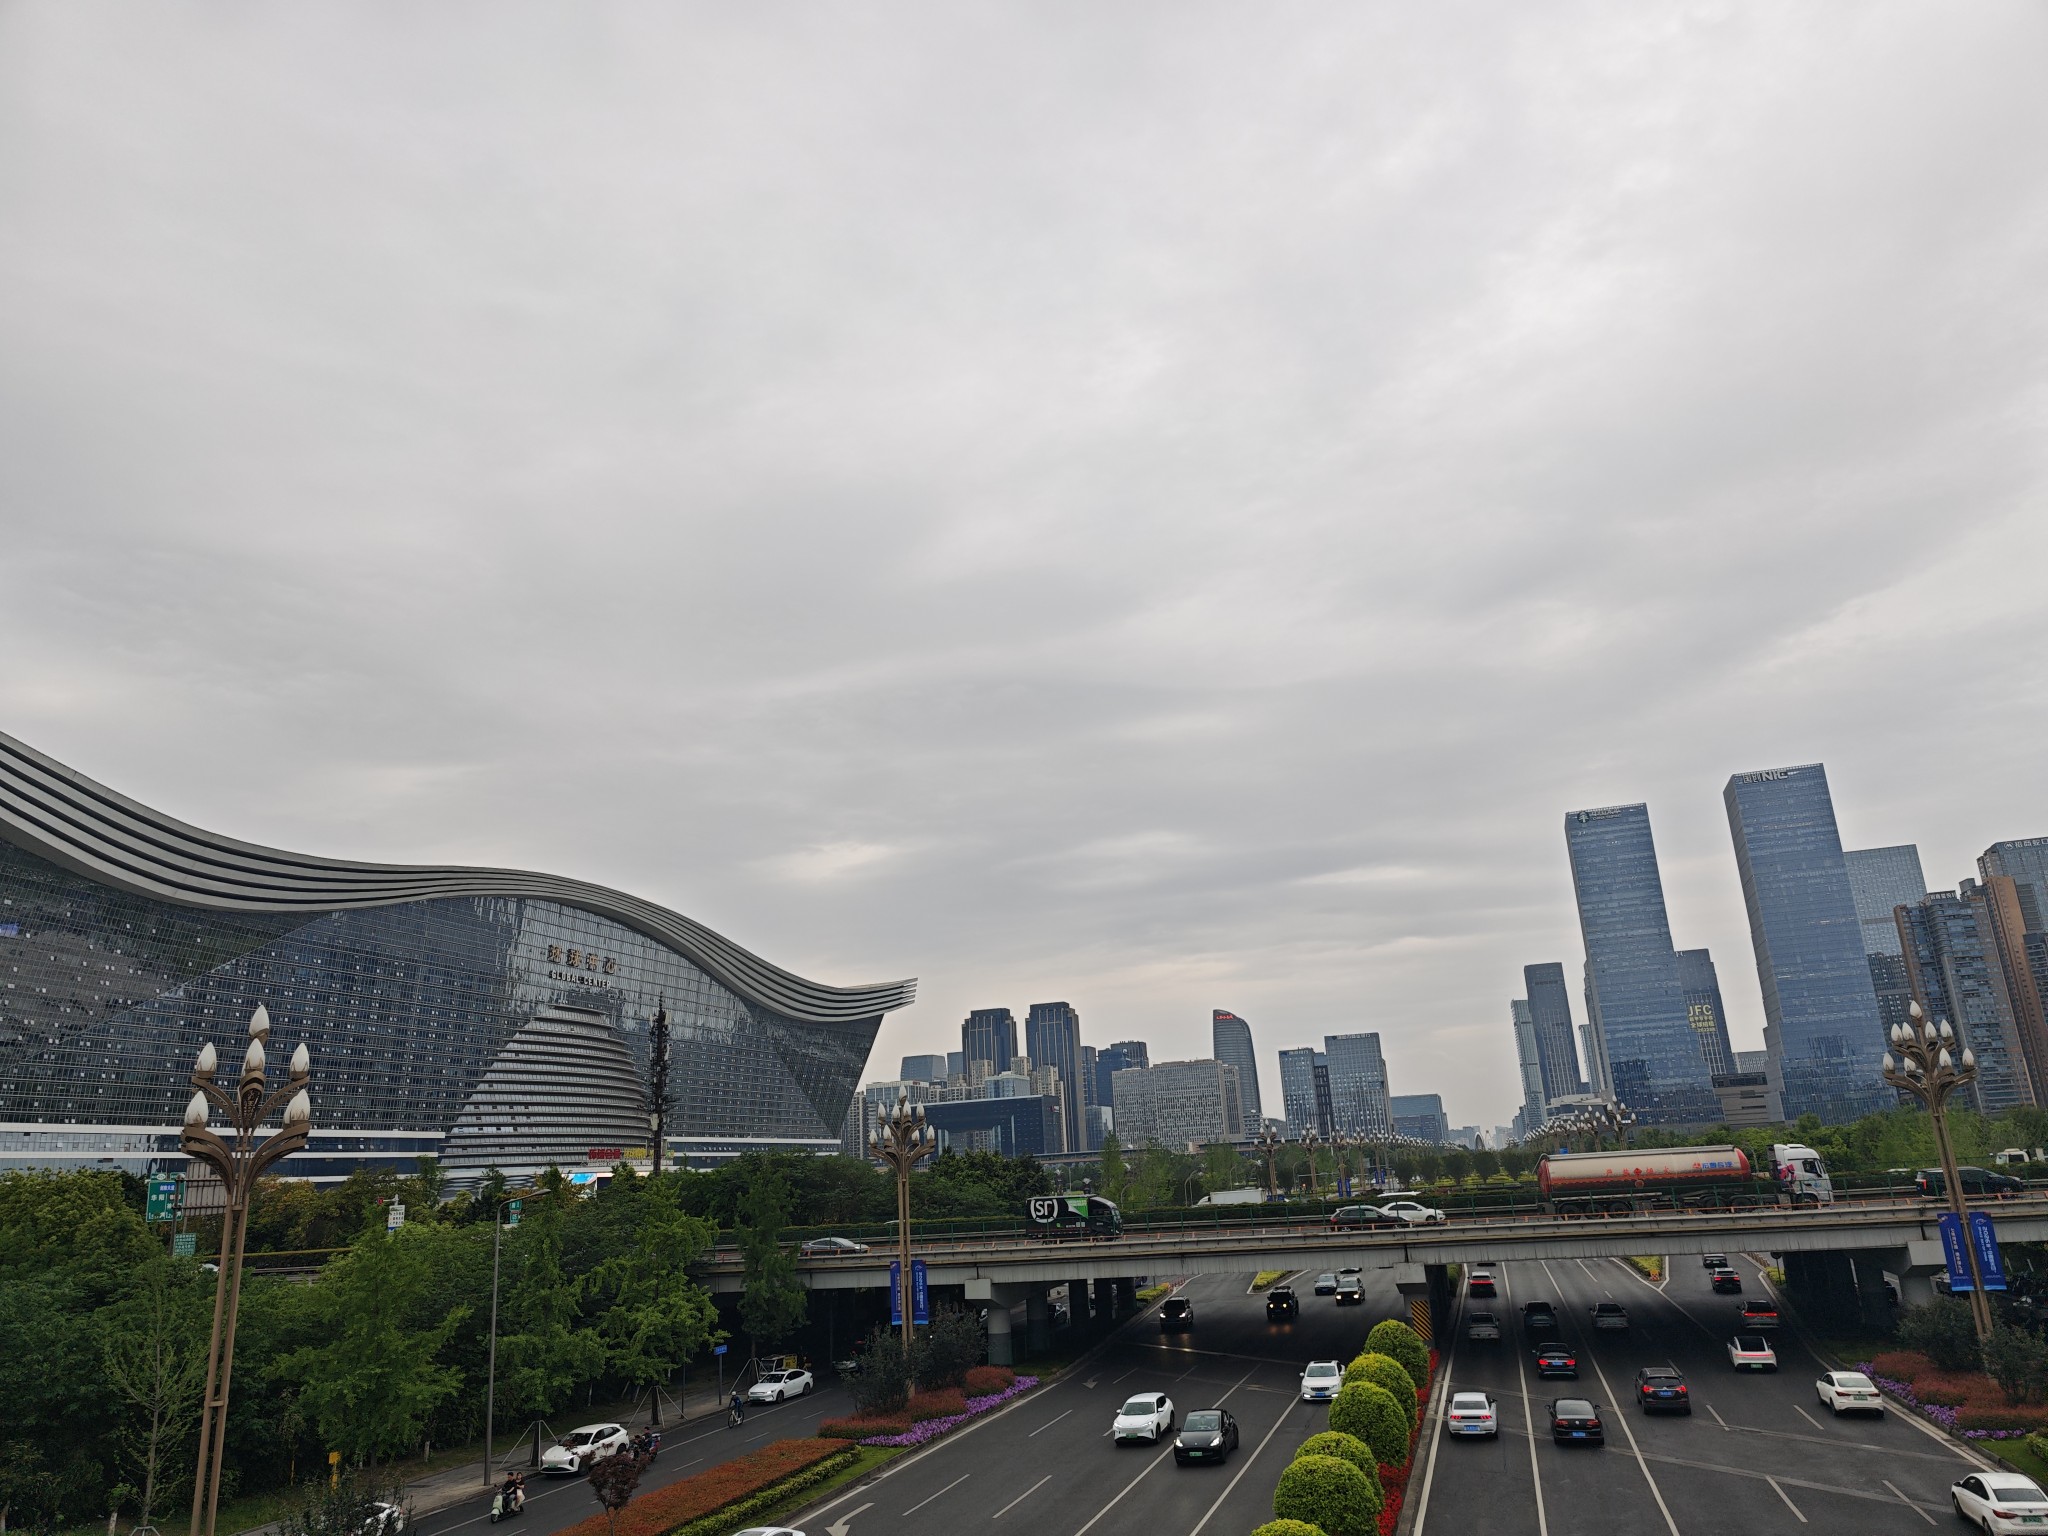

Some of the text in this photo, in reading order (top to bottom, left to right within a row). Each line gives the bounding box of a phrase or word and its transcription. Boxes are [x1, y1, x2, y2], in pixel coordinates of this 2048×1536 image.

[551, 969, 611, 989] GLOBAL CENTER
[1689, 1004, 1712, 1016] JFC
